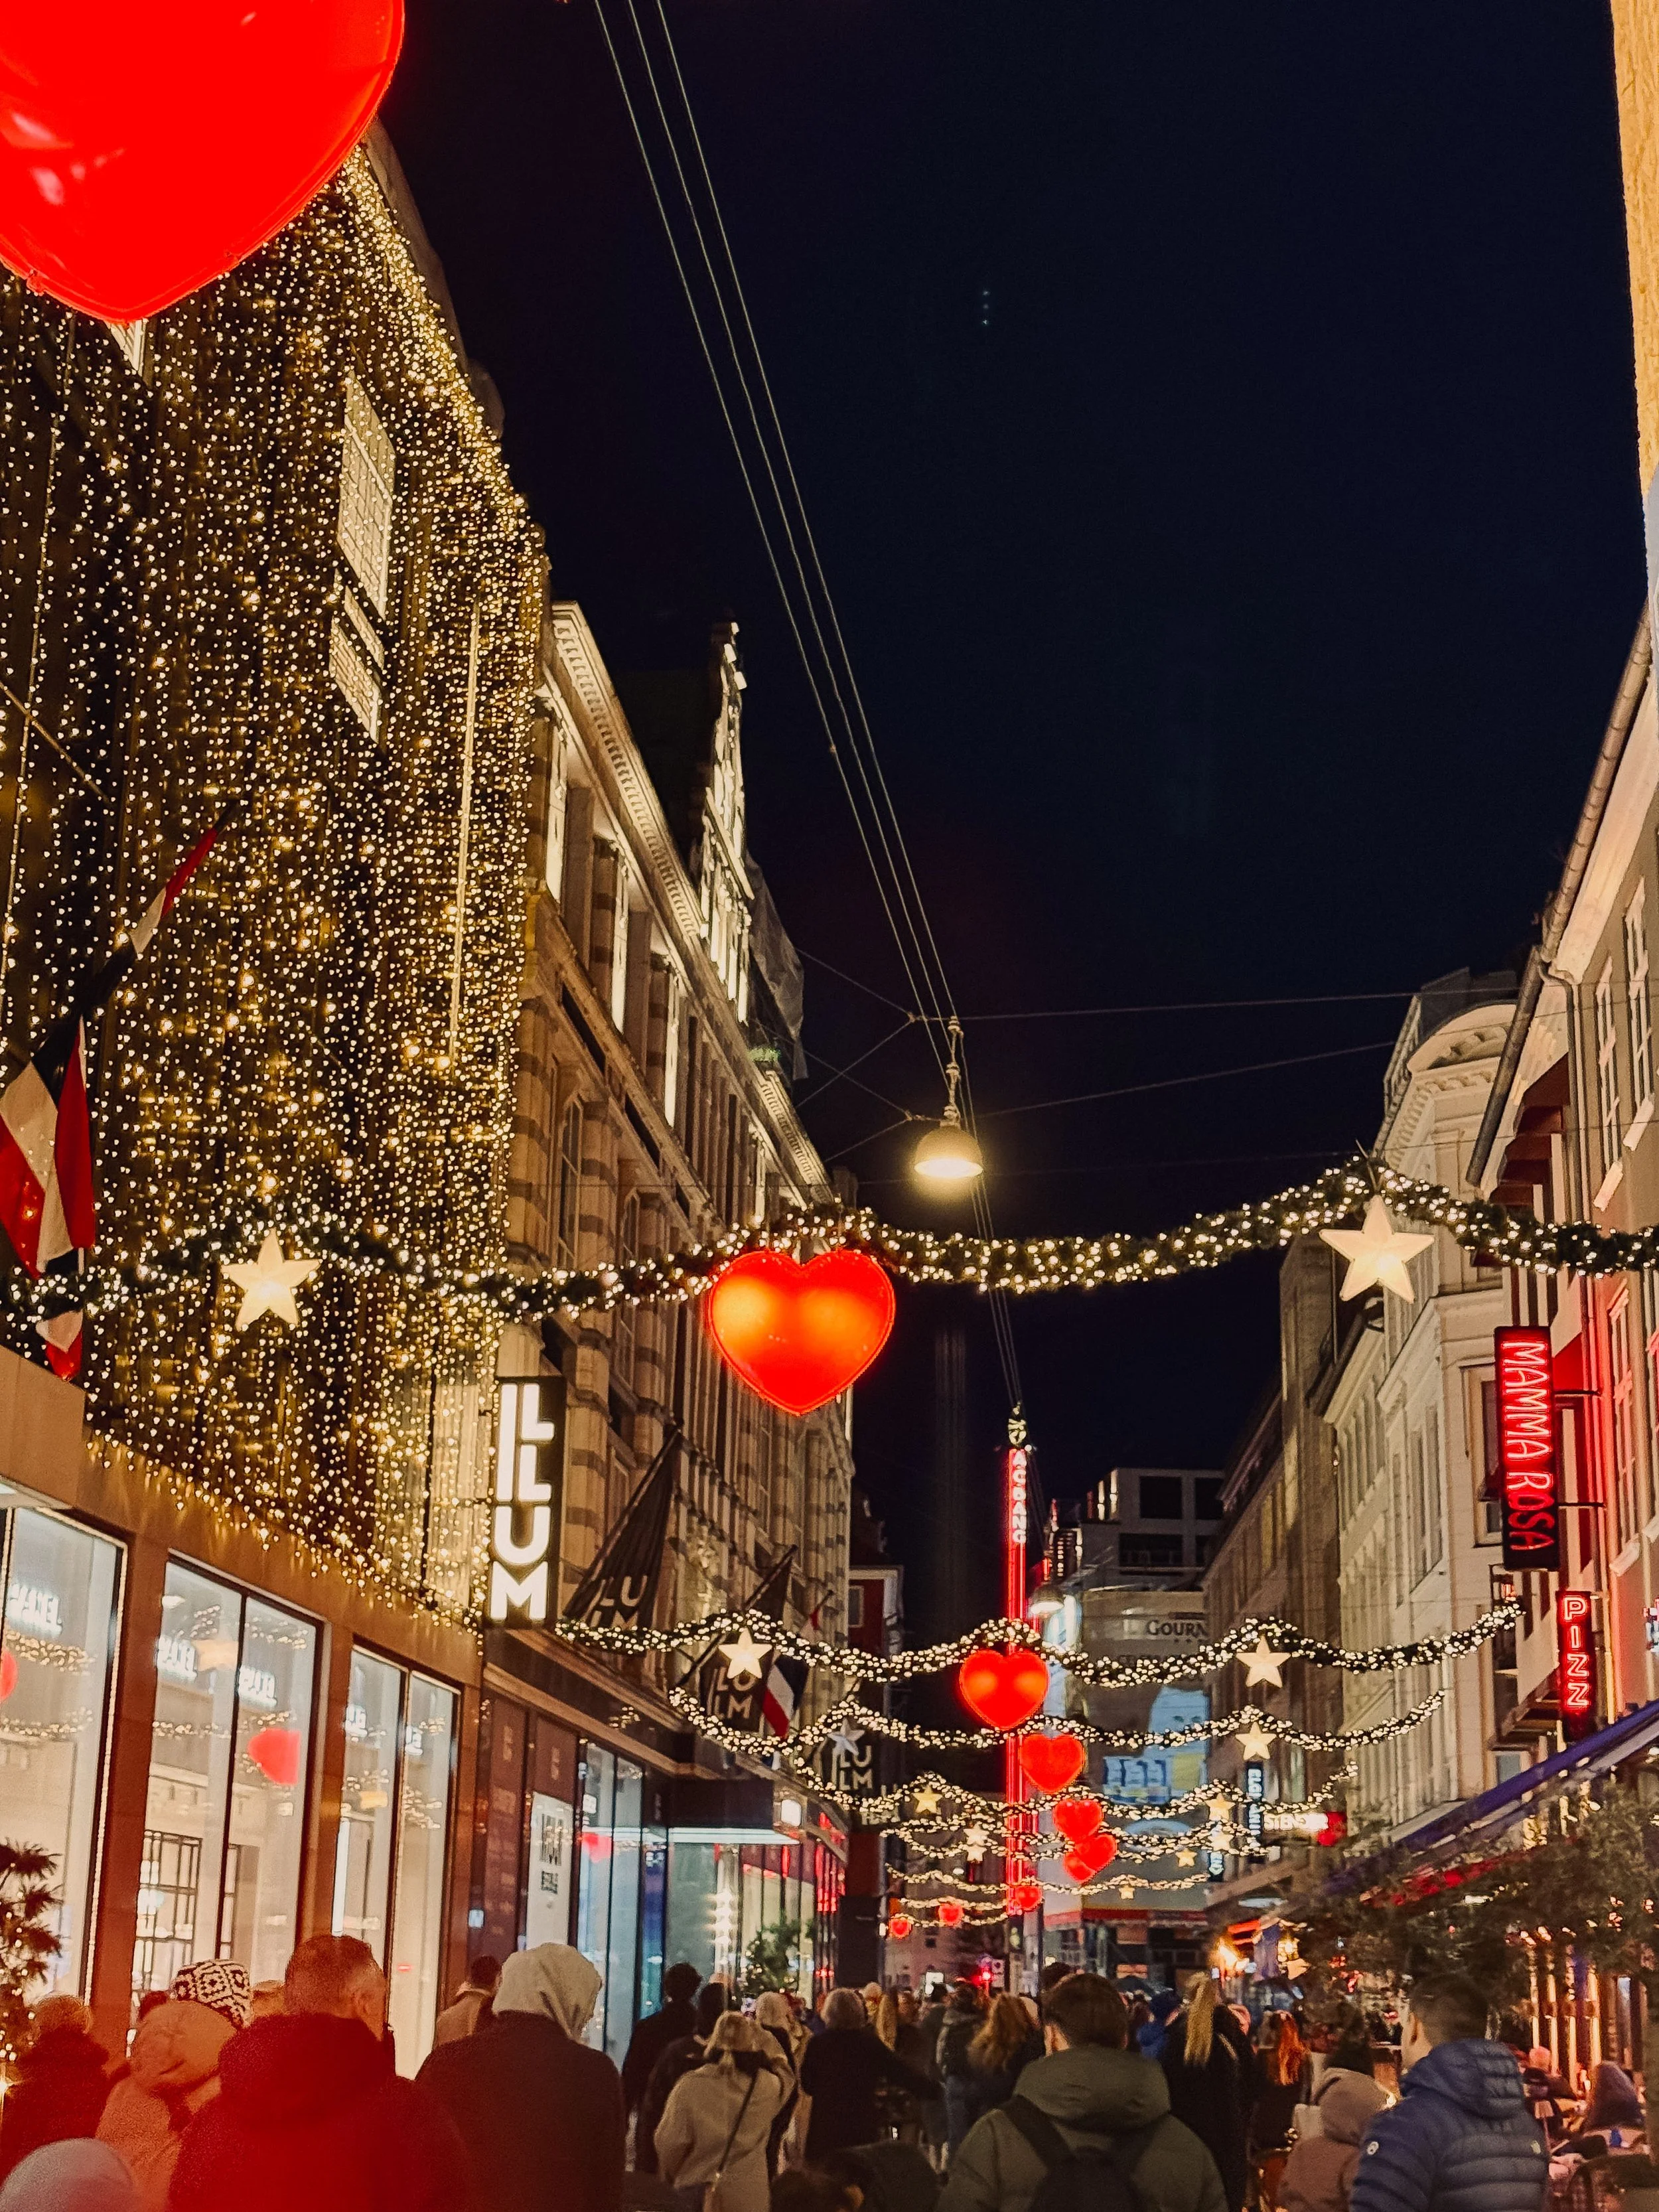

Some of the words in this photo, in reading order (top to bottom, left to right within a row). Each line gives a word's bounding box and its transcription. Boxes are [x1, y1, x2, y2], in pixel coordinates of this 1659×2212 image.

[1501, 1341, 1550, 1461] MAMMA
[490, 1382, 555, 1620] ILLUM
[1506, 1471, 1555, 1551] ROSA
